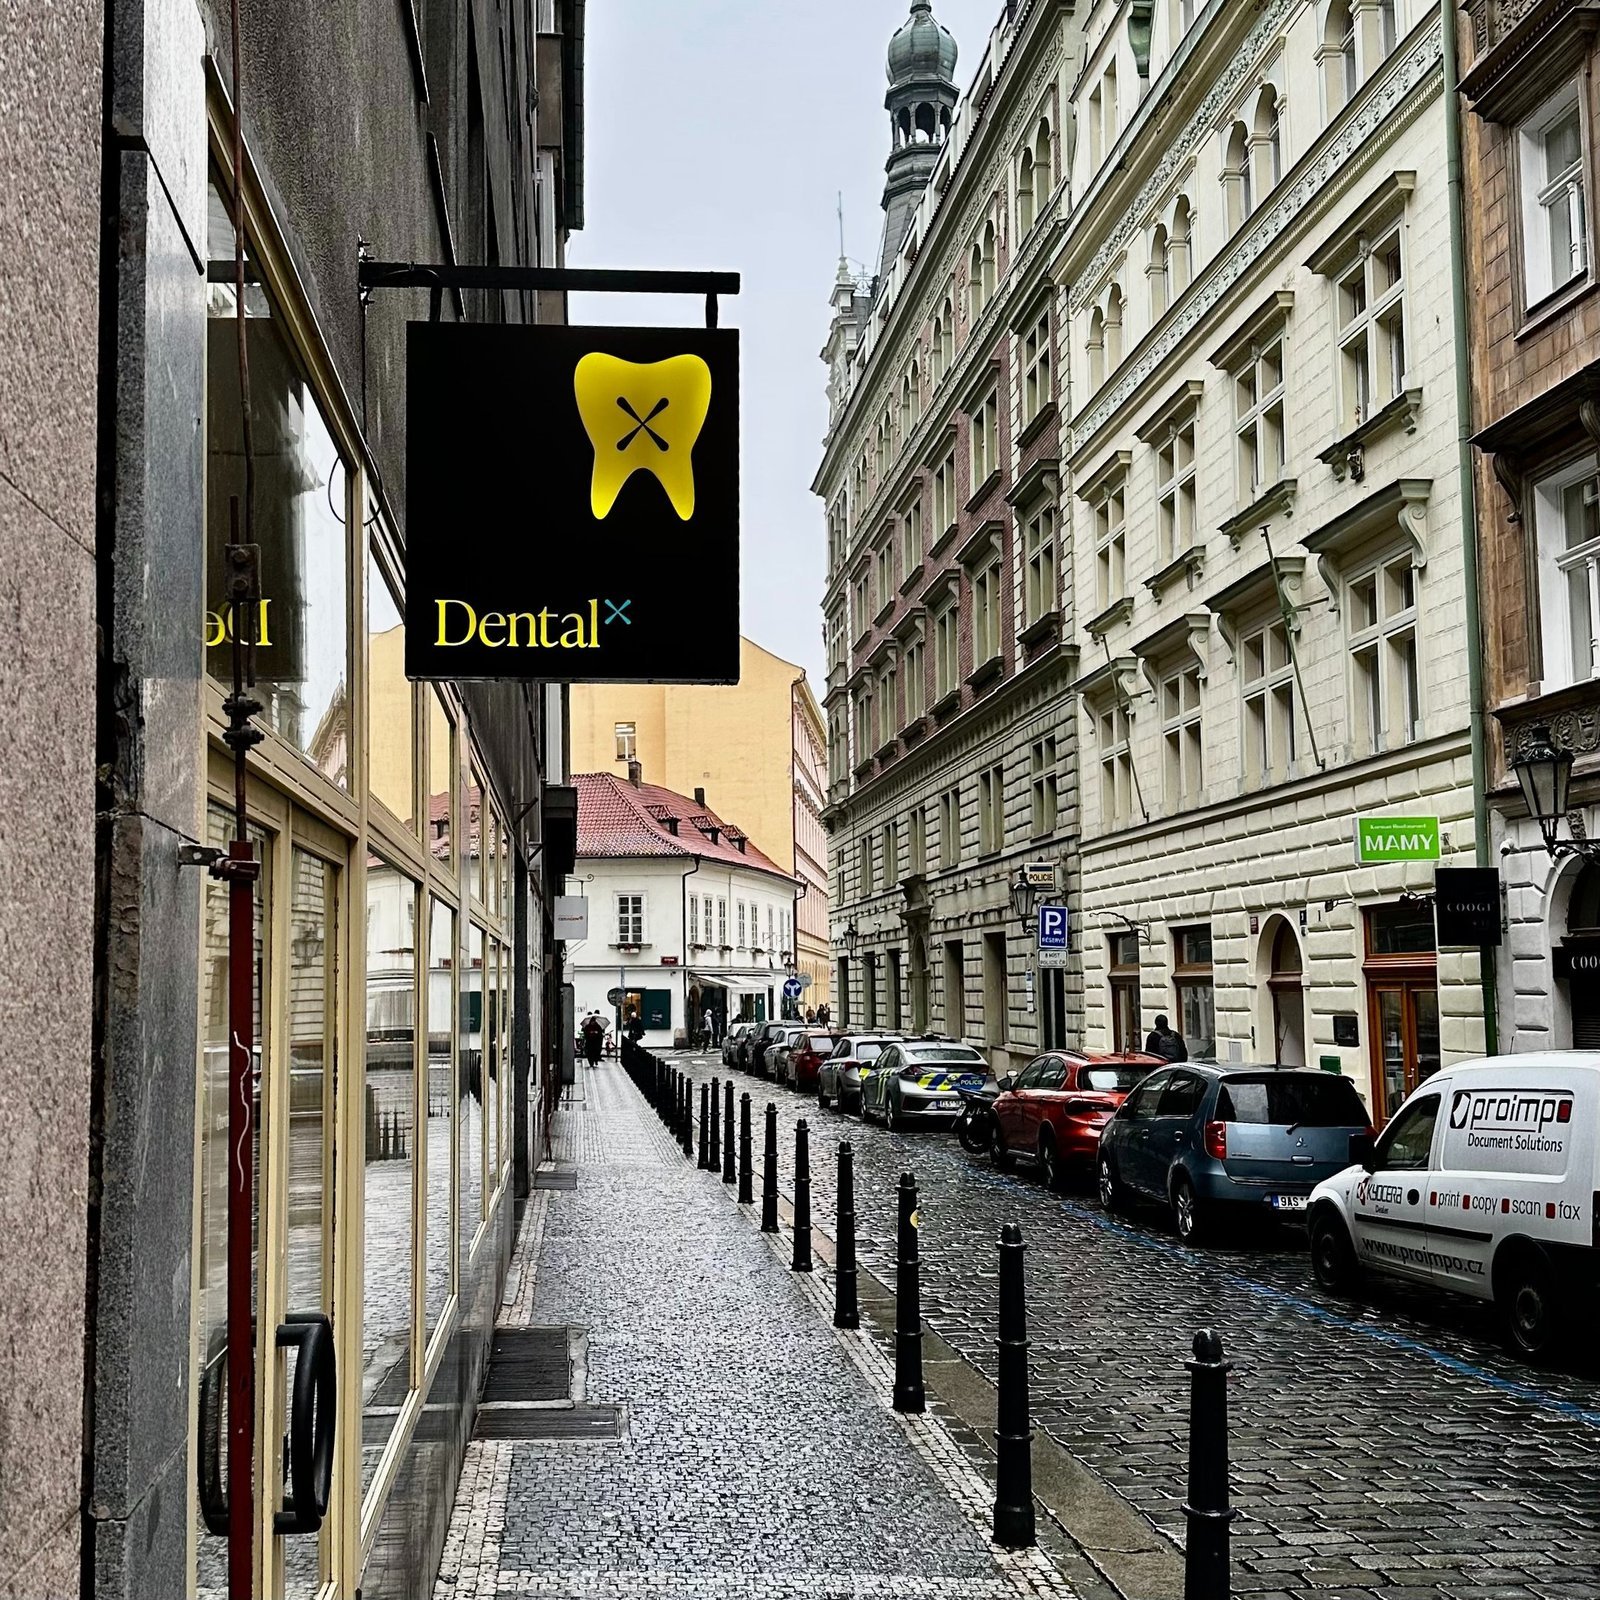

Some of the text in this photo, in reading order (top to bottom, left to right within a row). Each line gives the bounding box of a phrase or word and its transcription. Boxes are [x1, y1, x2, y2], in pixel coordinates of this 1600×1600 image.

[1365, 834, 1433, 851] MAMY
[1029, 873, 1053, 881] POLICIE
[1045, 911, 1062, 935] P
[1571, 955, 1600, 970] COO
[1470, 1094, 1573, 1133] proimpo
[1468, 1132, 1563, 1153] Document Solutions
[1366, 1183, 1403, 1205] KYOCERA
[1438, 1190, 1581, 1221] print copy scan fax
[1361, 1237, 1485, 1275] www.proimpo.cz
